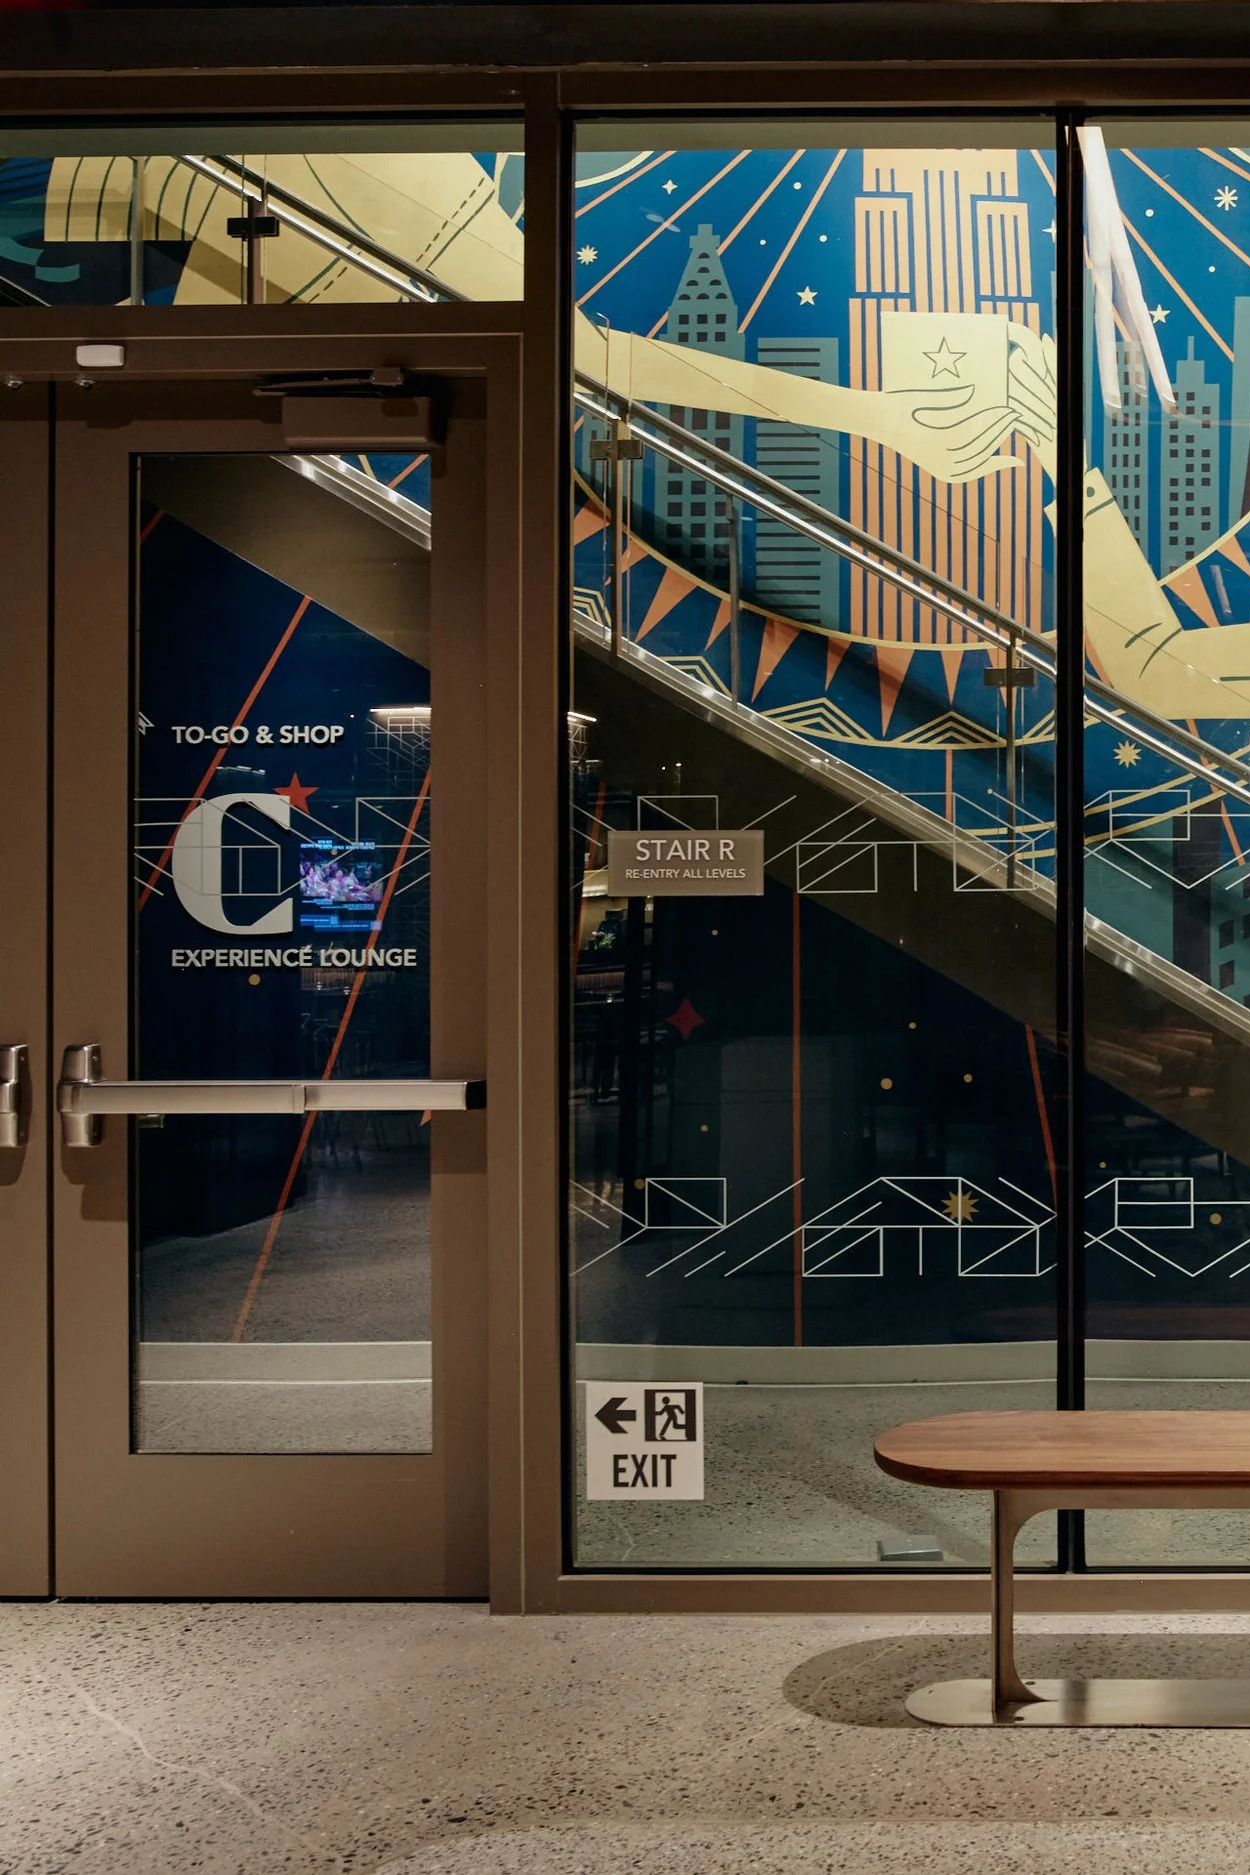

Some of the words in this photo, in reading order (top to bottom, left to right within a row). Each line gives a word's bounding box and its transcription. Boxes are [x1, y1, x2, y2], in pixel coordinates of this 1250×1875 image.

[172, 725, 249, 745] TO-GO
[256, 725, 274, 745] &
[279, 725, 345, 745] SHOP
[636, 839, 710, 861] STAIR
[719, 839, 735, 861] R
[625, 868, 681, 879] RE-ENTRY
[682, 868, 704, 879] ALL
[706, 868, 747, 879] LEVELS
[171, 949, 313, 968] EXPERIENCE
[320, 949, 418, 968] LOUNGE
[613, 1454, 677, 1488] EXIT
